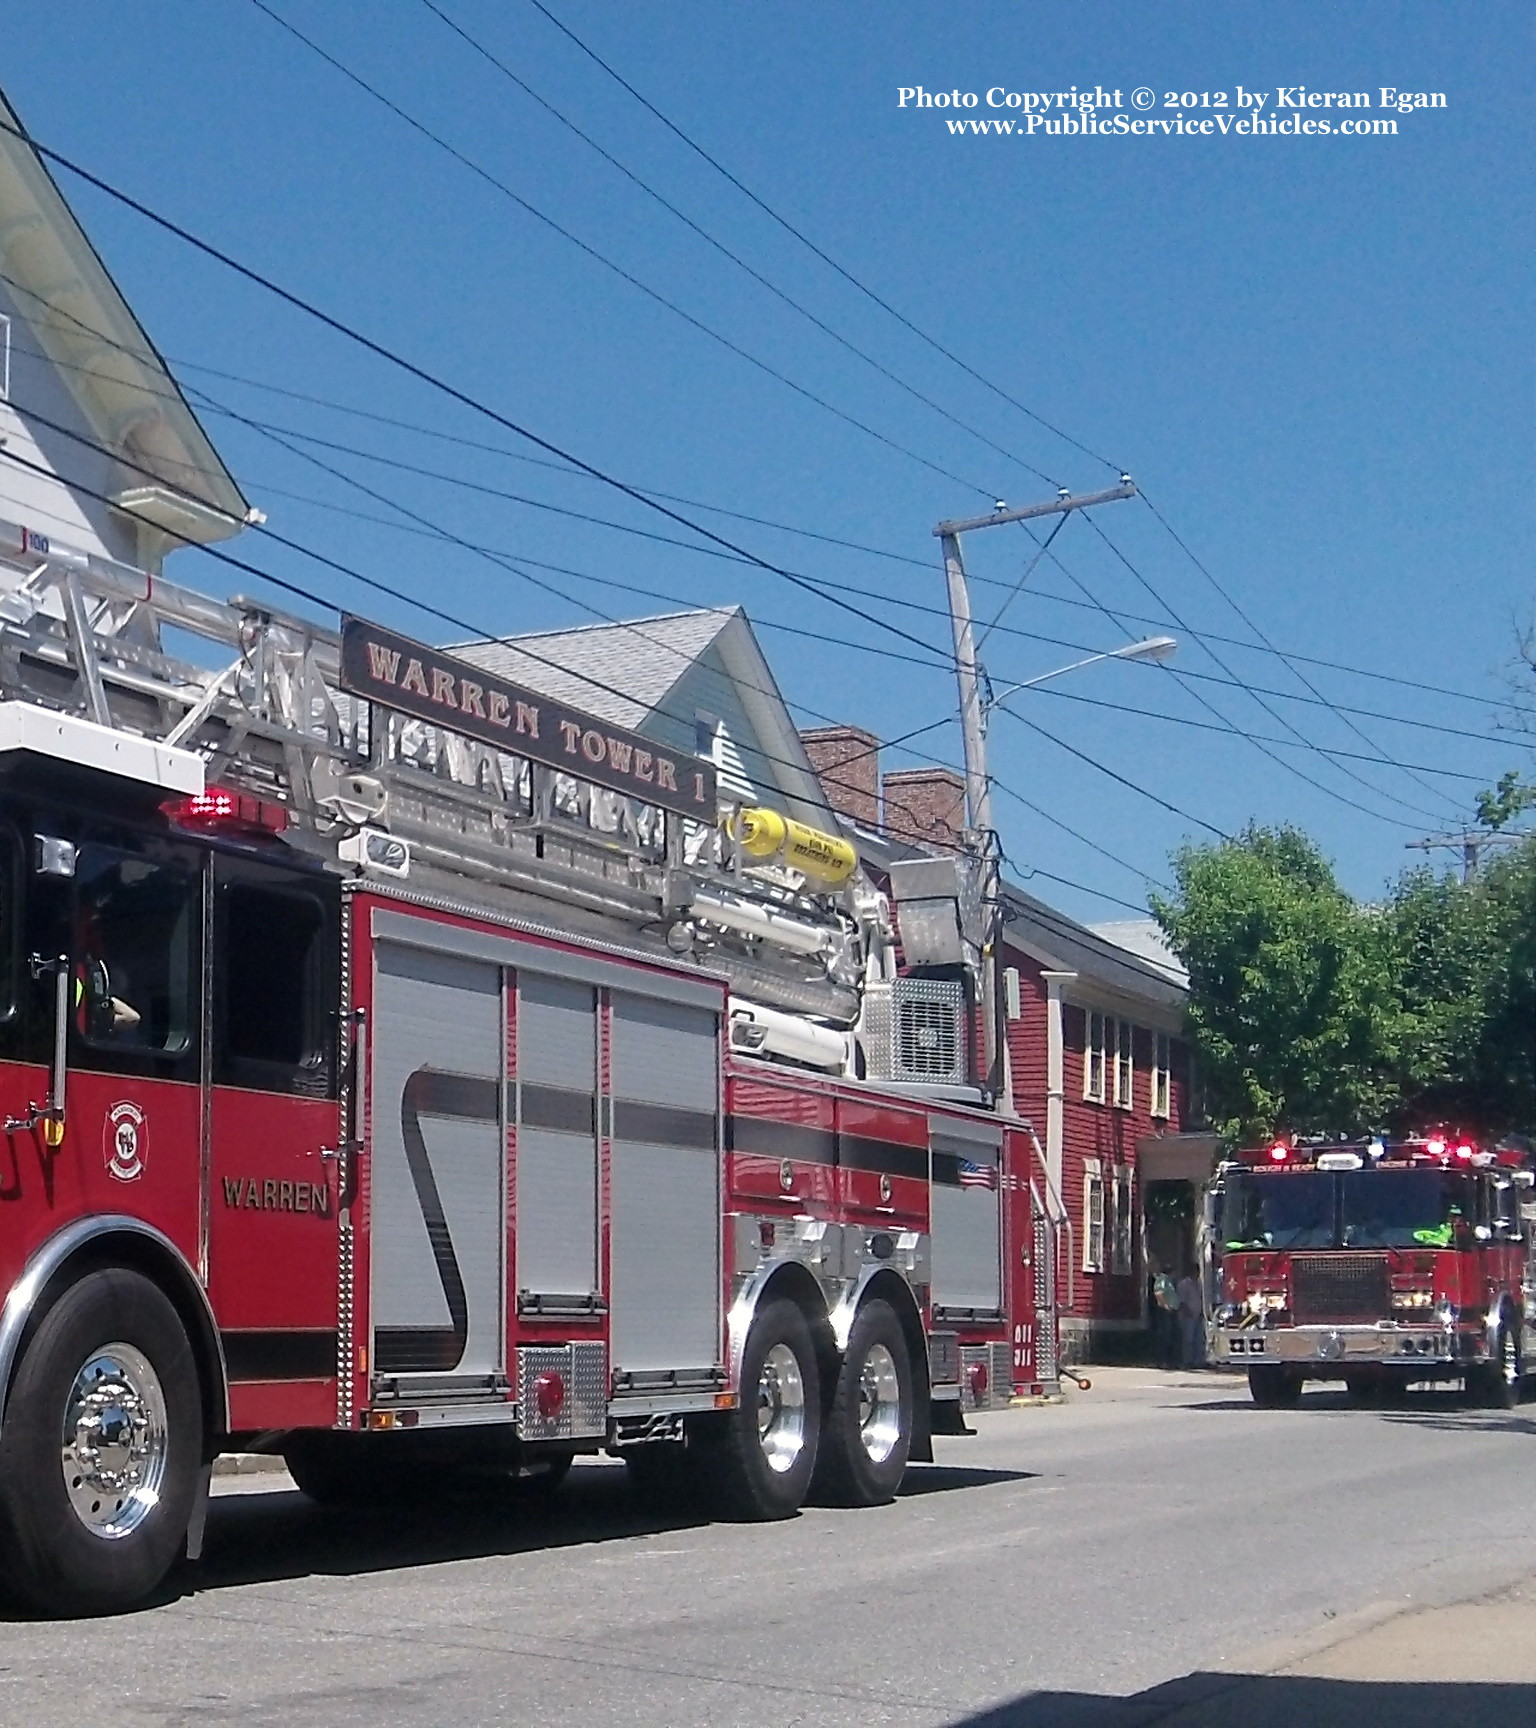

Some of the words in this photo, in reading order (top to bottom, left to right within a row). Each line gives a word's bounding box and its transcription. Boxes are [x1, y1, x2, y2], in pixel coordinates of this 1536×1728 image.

[29, 534, 49, 553] 100
[368, 641, 540, 739] WARREN
[560, 719, 678, 792] TOWER
[694, 773, 706, 803] 1
[224, 1176, 329, 1214] WARREN
